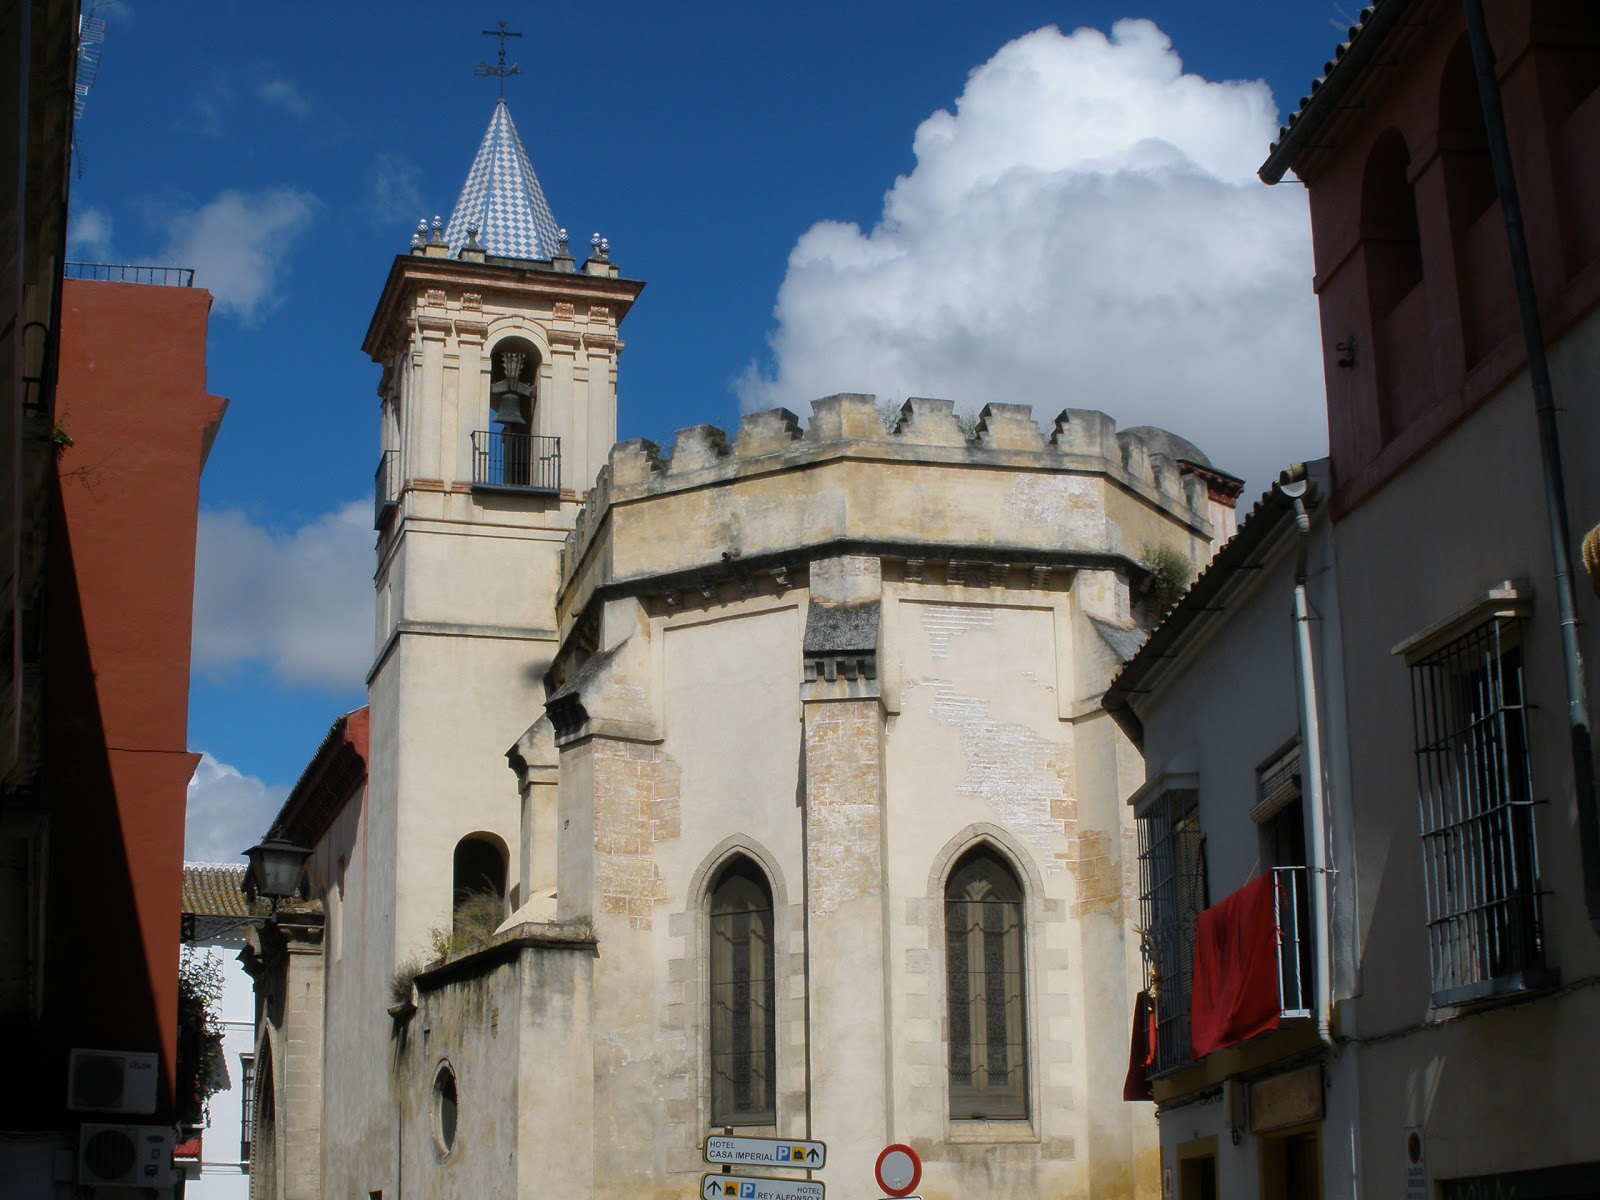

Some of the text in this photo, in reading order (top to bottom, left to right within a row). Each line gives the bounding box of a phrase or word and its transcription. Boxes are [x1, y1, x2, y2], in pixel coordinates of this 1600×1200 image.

[709, 1141, 735, 1149] HOTEL
[709, 1150, 774, 1161] CASA IMPERIAL
[778, 1146, 789, 1160] P
[743, 1184, 754, 1198] P
[757, 1192, 774, 1200] REY
